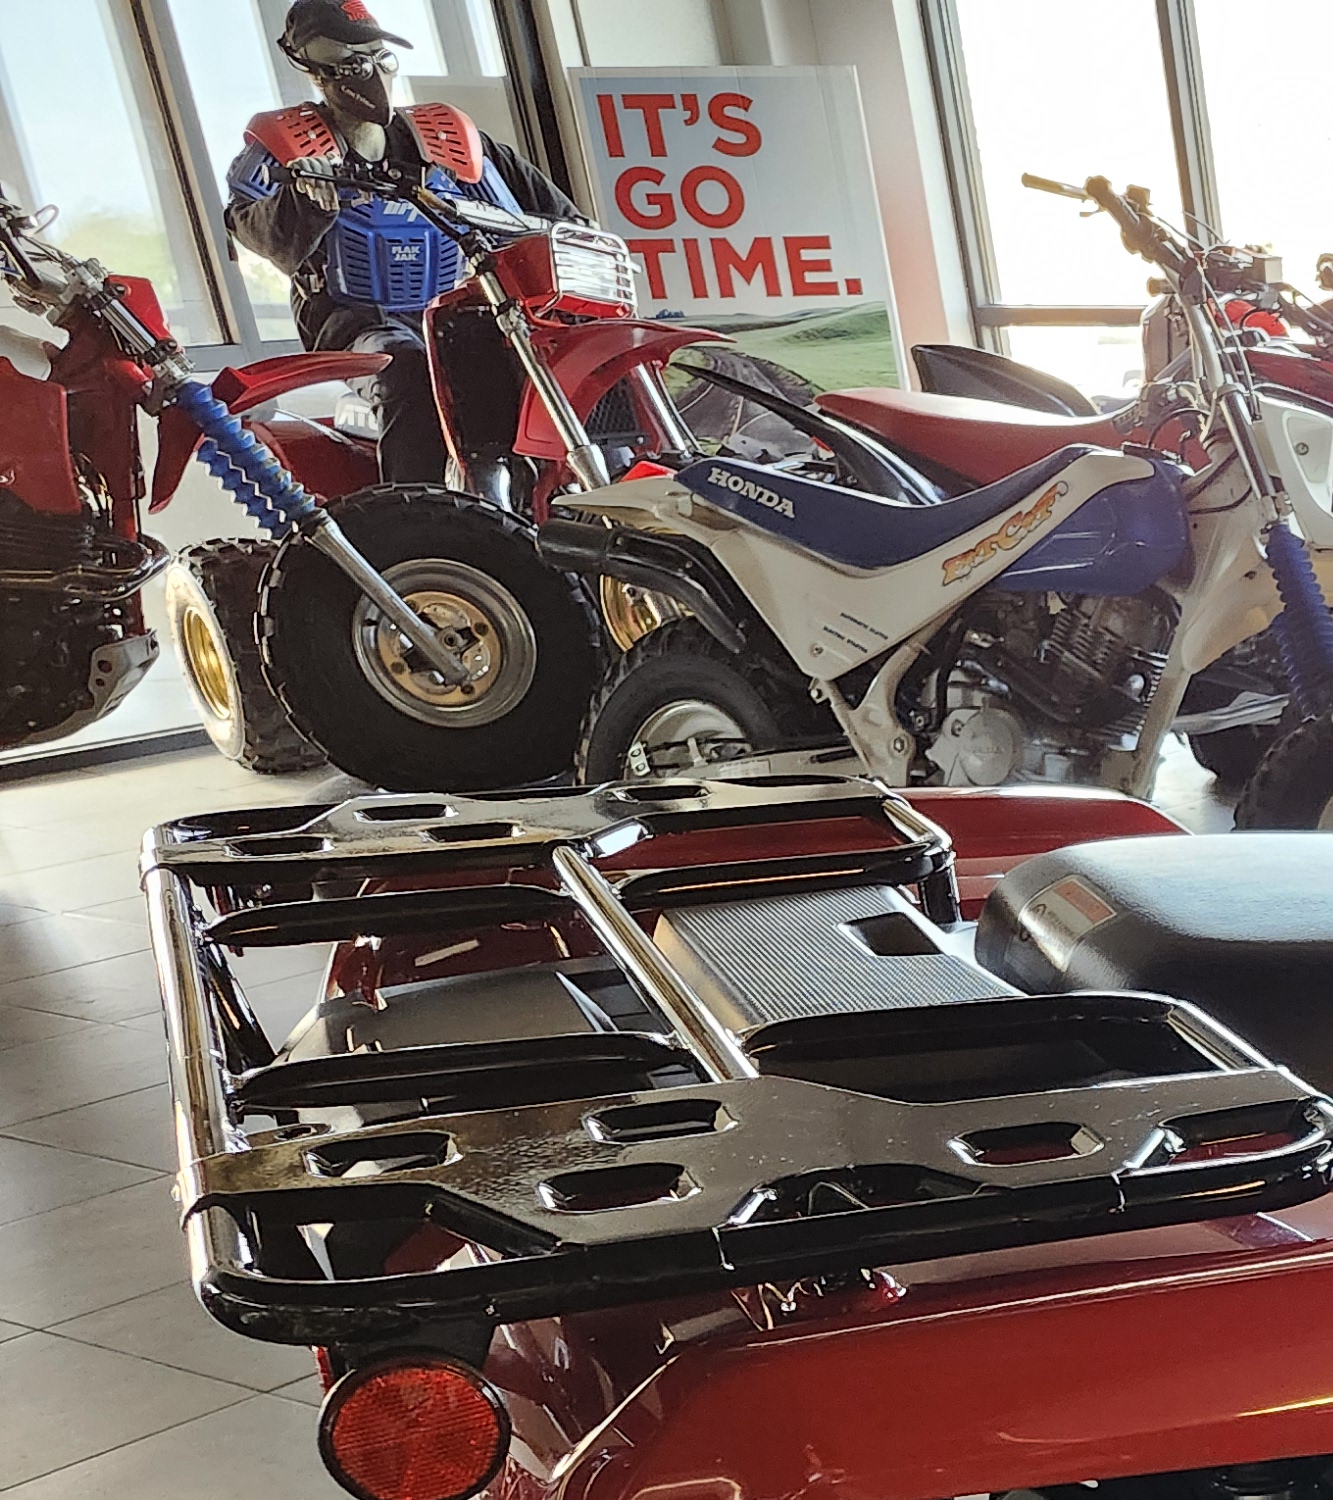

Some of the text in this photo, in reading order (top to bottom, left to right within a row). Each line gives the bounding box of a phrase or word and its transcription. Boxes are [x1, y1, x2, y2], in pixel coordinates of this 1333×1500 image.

[598, 93, 761, 157] IT'S
[615, 166, 744, 229] GO
[628, 236, 861, 299] TIME.
[707, 467, 796, 519] HONDA
